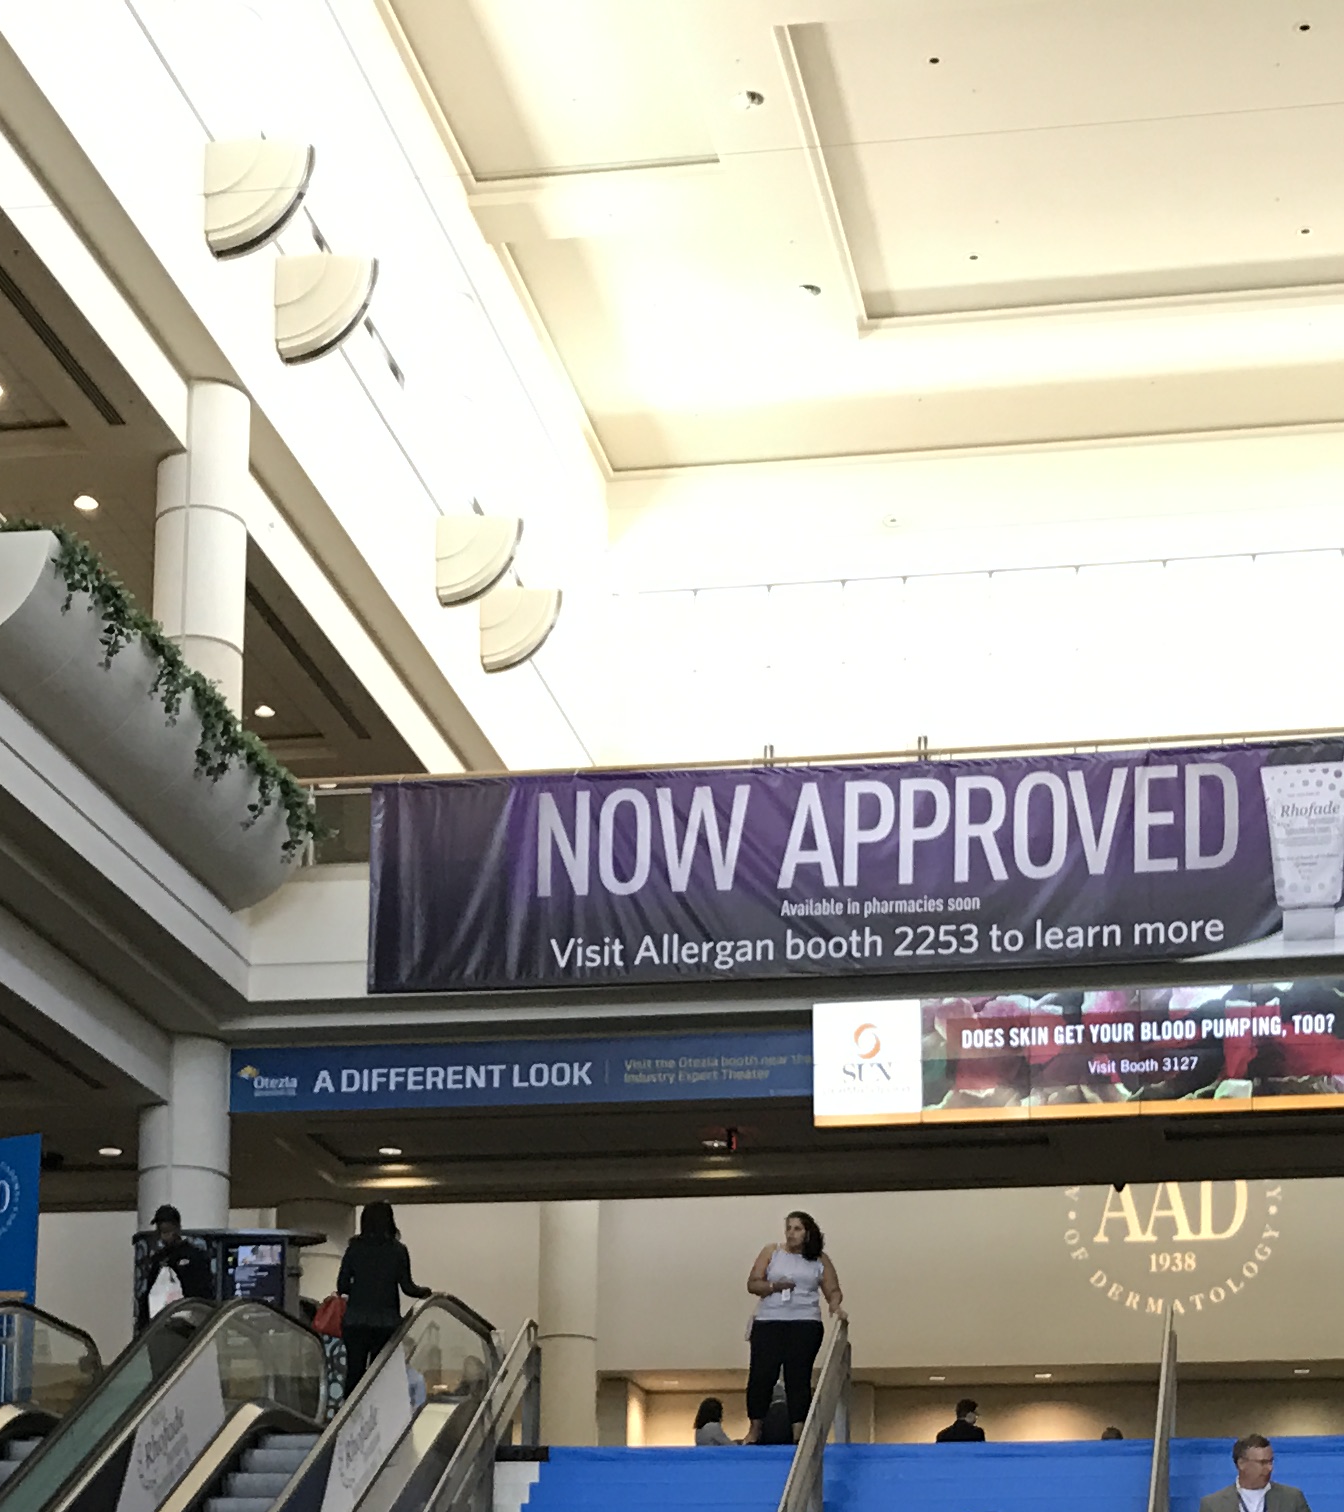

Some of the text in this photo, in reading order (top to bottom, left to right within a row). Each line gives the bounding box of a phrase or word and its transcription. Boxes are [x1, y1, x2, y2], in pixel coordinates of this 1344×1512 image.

[1280, 800, 1341, 818] Rhofade
[537, 785, 752, 898] NOW
[776, 762, 1240, 890] APPROVED
[780, 896, 981, 918] Available in pharmacies soon
[550, 918, 1225, 971] Visit Allergan booth 2253 to learn more
[961, 1013, 1336, 1049] DOES SKIN GET YOUR BLOOD PUMPING, TOO?
[312, 1061, 593, 1094] A DIFFERENT LOOK
[623, 1059, 652, 1072] Visit
[623, 1068, 771, 1084] Industry Expert Theater
[1087, 1056, 1199, 1076] Visit Booth 3127
[253, 1075, 298, 1090] Otezla
[1092, 1180, 1249, 1243] AAD
[1063, 1228, 1090, 1262] OF
[1088, 1223, 1281, 1316] DERMATOLOGY
[1149, 1251, 1197, 1273] 1938
